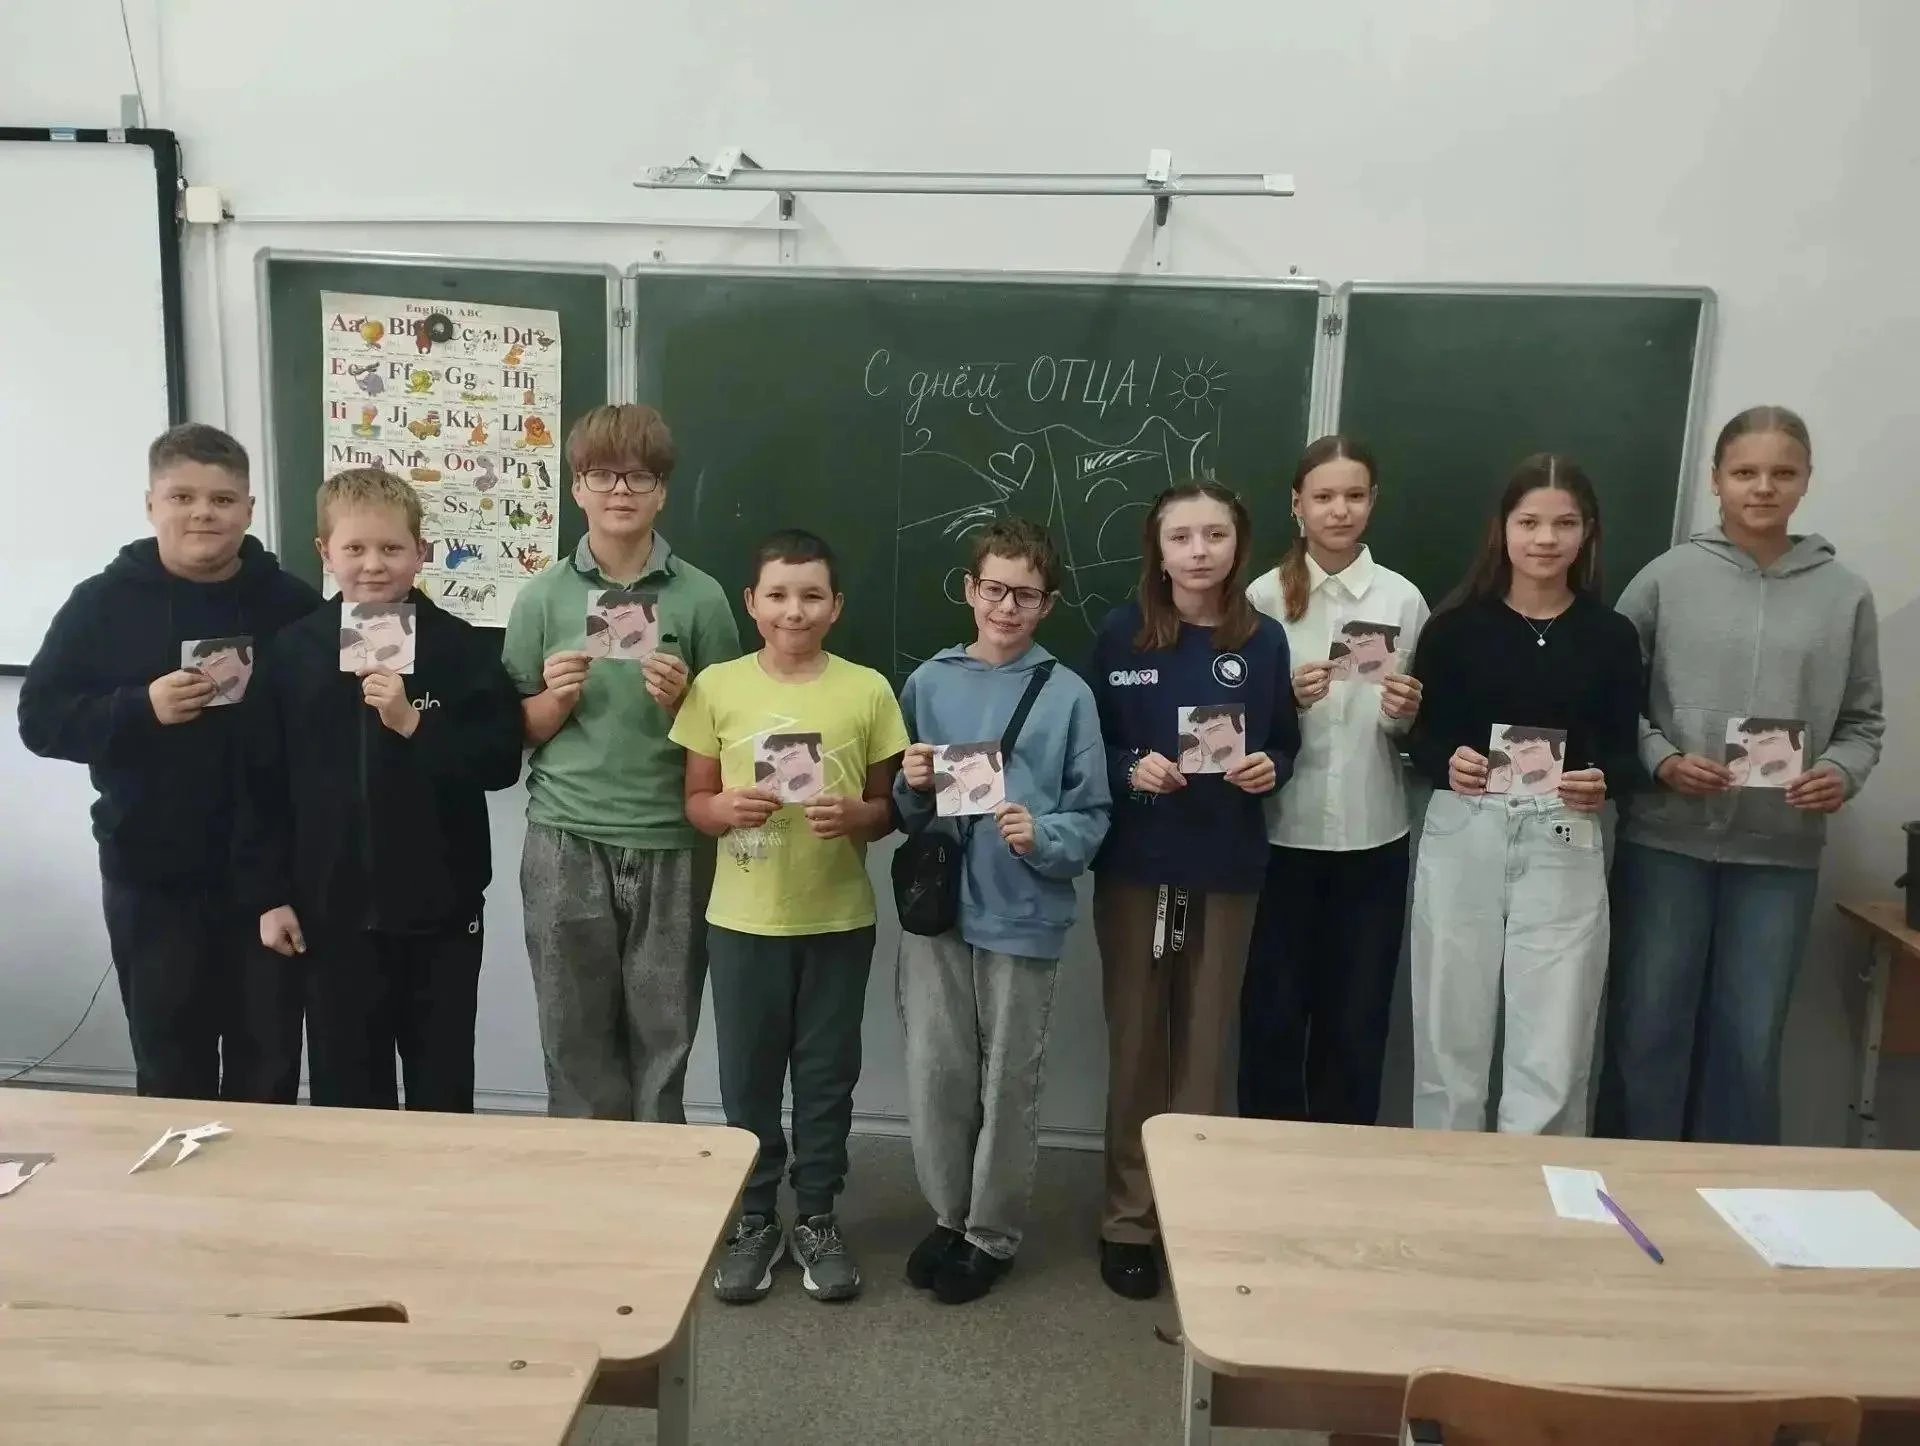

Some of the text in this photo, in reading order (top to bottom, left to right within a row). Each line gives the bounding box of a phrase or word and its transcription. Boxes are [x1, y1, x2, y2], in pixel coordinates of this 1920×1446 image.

[405, 304, 482, 318] English ABC
[330, 313, 361, 334] Aa
[503, 326, 533, 346] Dd
[331, 357, 535, 391] Ee Ff Gg Hh
[905, 364, 1001, 426] днём
[1026, 353, 1163, 421] ОТЦА!
[330, 400, 523, 432] Ii Jj Kk Ll
[331, 444, 373, 464] Mm
[387, 448, 419, 468] Nn
[443, 453, 476, 472] Oo
[502, 456, 529, 479] Pp
[443, 495, 469, 514] Ss
[442, 580, 469, 598] Zz
